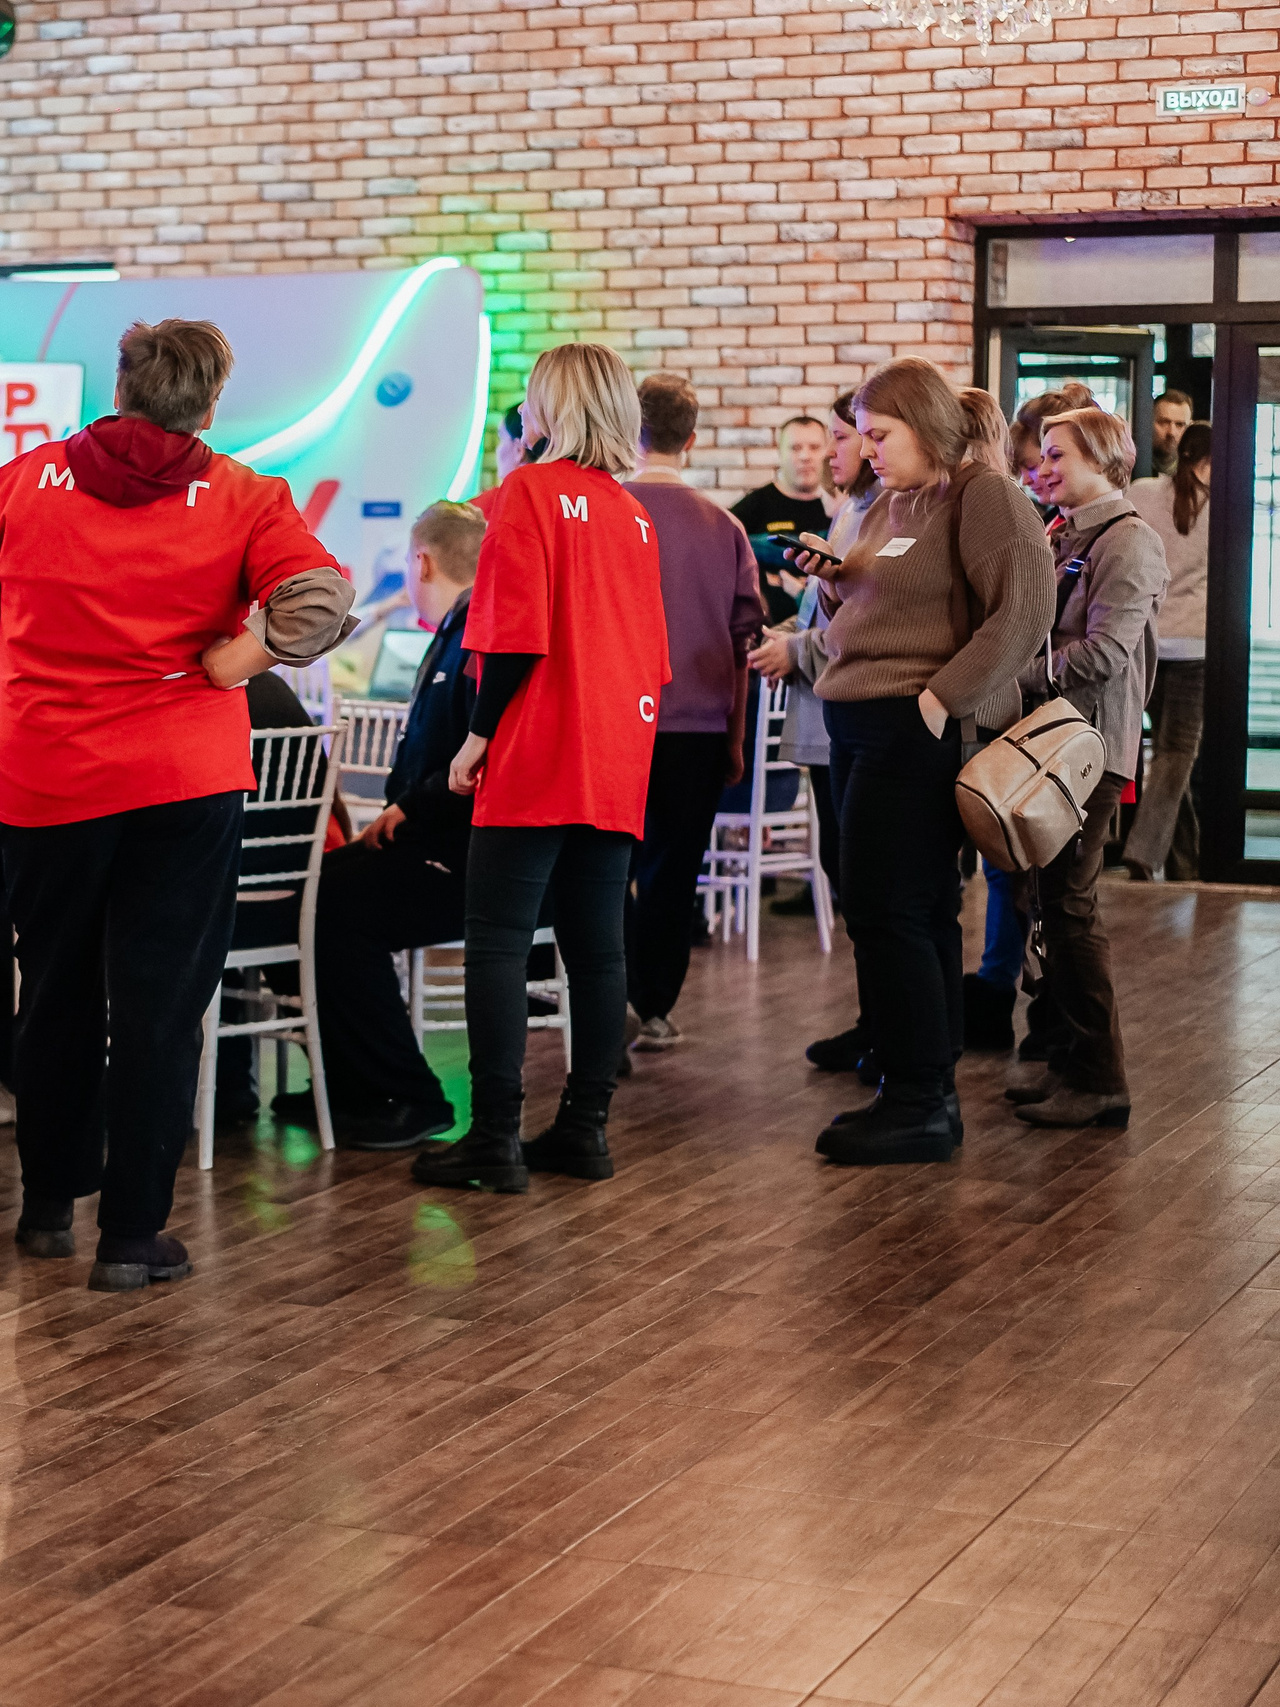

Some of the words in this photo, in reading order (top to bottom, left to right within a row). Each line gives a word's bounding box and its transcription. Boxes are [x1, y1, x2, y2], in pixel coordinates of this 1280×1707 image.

[1166, 89, 1236, 108] ВЫХОД
[558, 494, 589, 522] М
[634, 515, 650, 544] Т
[639, 695, 655, 723] С
